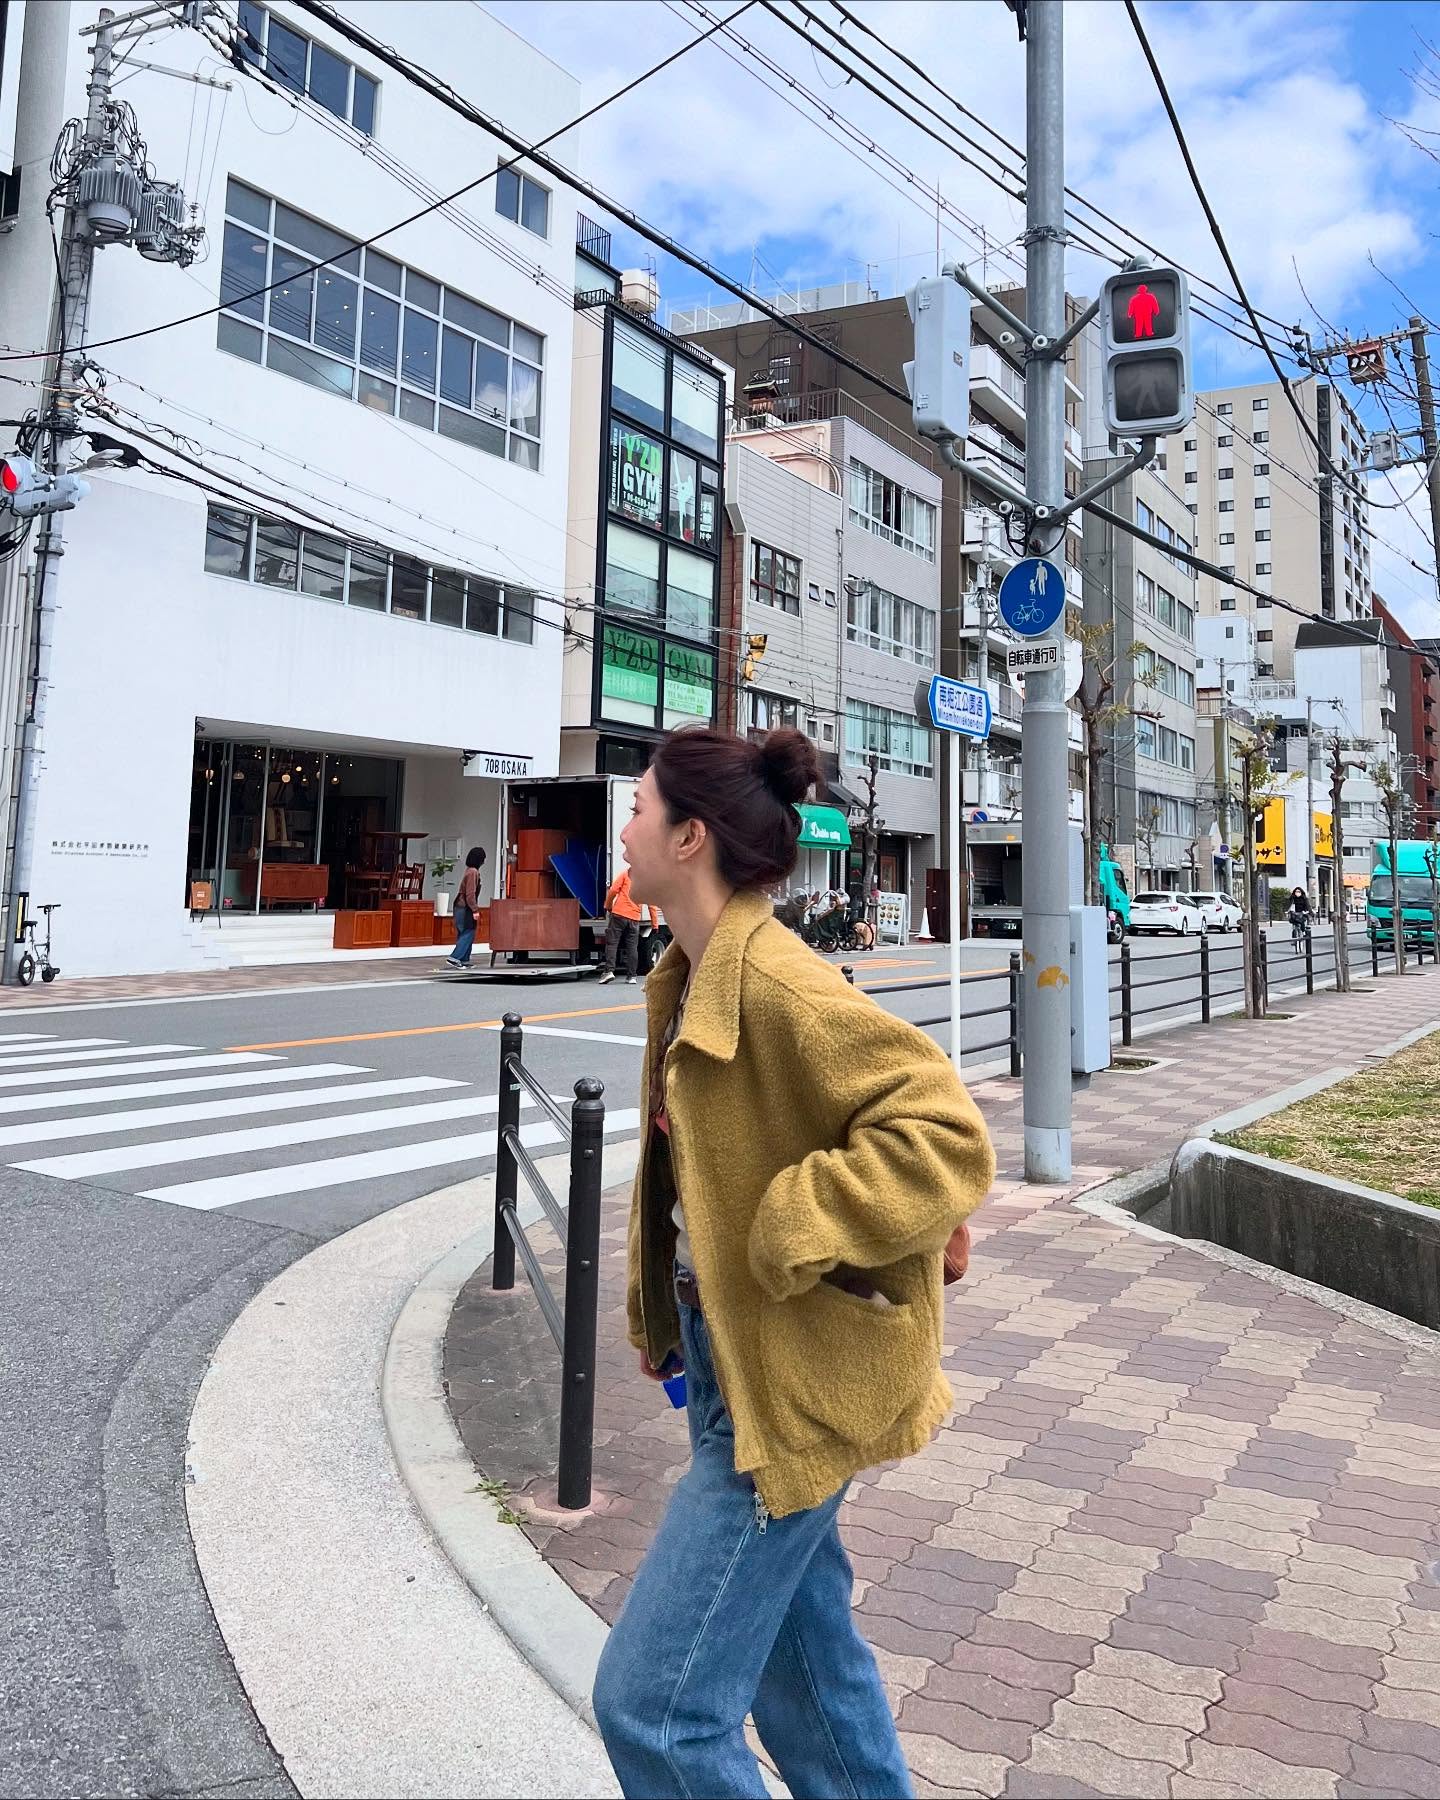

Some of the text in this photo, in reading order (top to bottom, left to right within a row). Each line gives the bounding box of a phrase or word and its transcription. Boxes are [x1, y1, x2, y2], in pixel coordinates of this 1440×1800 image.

[624, 432, 660, 476] Y'ZD
[623, 461, 661, 504] GYM
[608, 629, 653, 671] Y'ZD
[1009, 646, 1057, 667] 自転車通行可
[485, 758, 527, 776] 70B OSAKA
